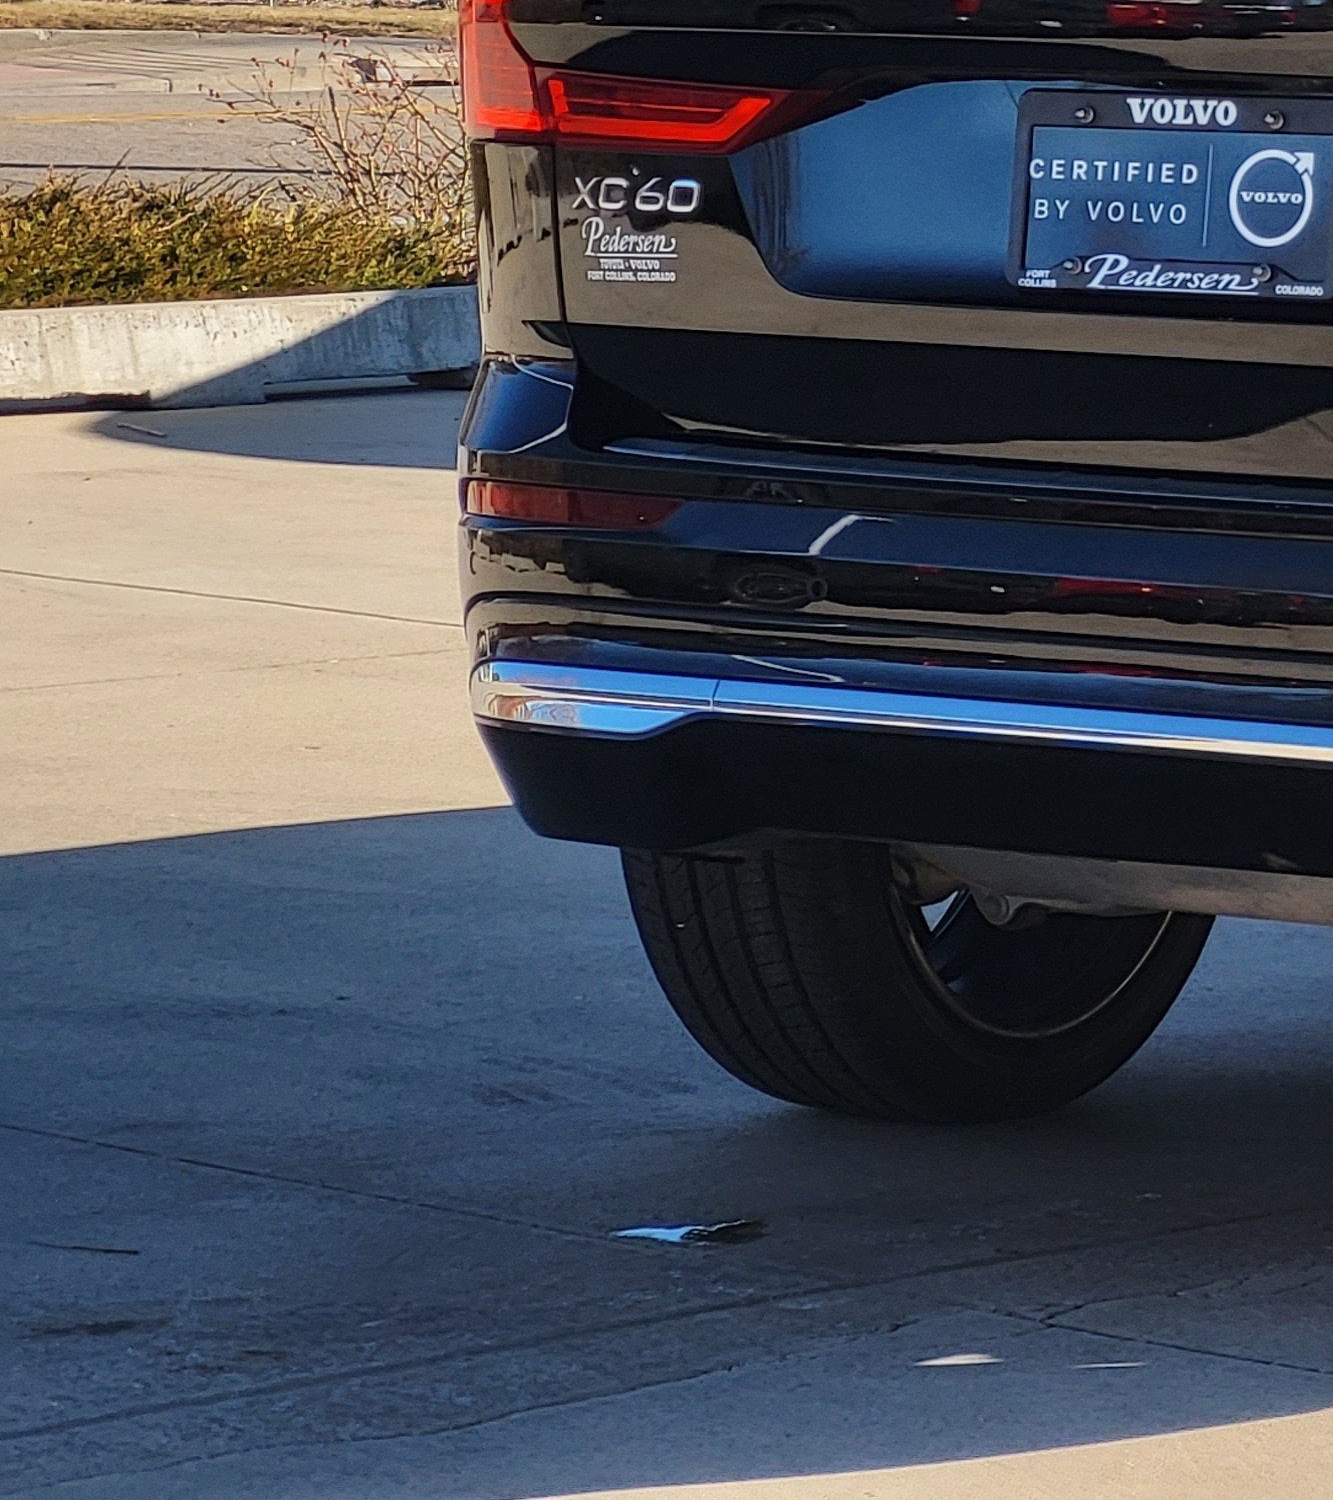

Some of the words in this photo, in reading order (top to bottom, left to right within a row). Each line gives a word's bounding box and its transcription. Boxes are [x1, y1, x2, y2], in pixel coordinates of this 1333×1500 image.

[1126, 98, 1238, 127] VOLVO
[1029, 158, 1199, 184] CERTIFIED
[572, 176, 701, 213] XC60
[1240, 190, 1303, 205] VOLVO
[1033, 199, 1071, 221] BY
[1086, 201, 1188, 225] VOLVO
[581, 216, 679, 258] Pedersen
[629, 259, 661, 271] VOLVO
[1084, 253, 1260, 295] Pedersen
[1275, 284, 1324, 297] COLORADO
